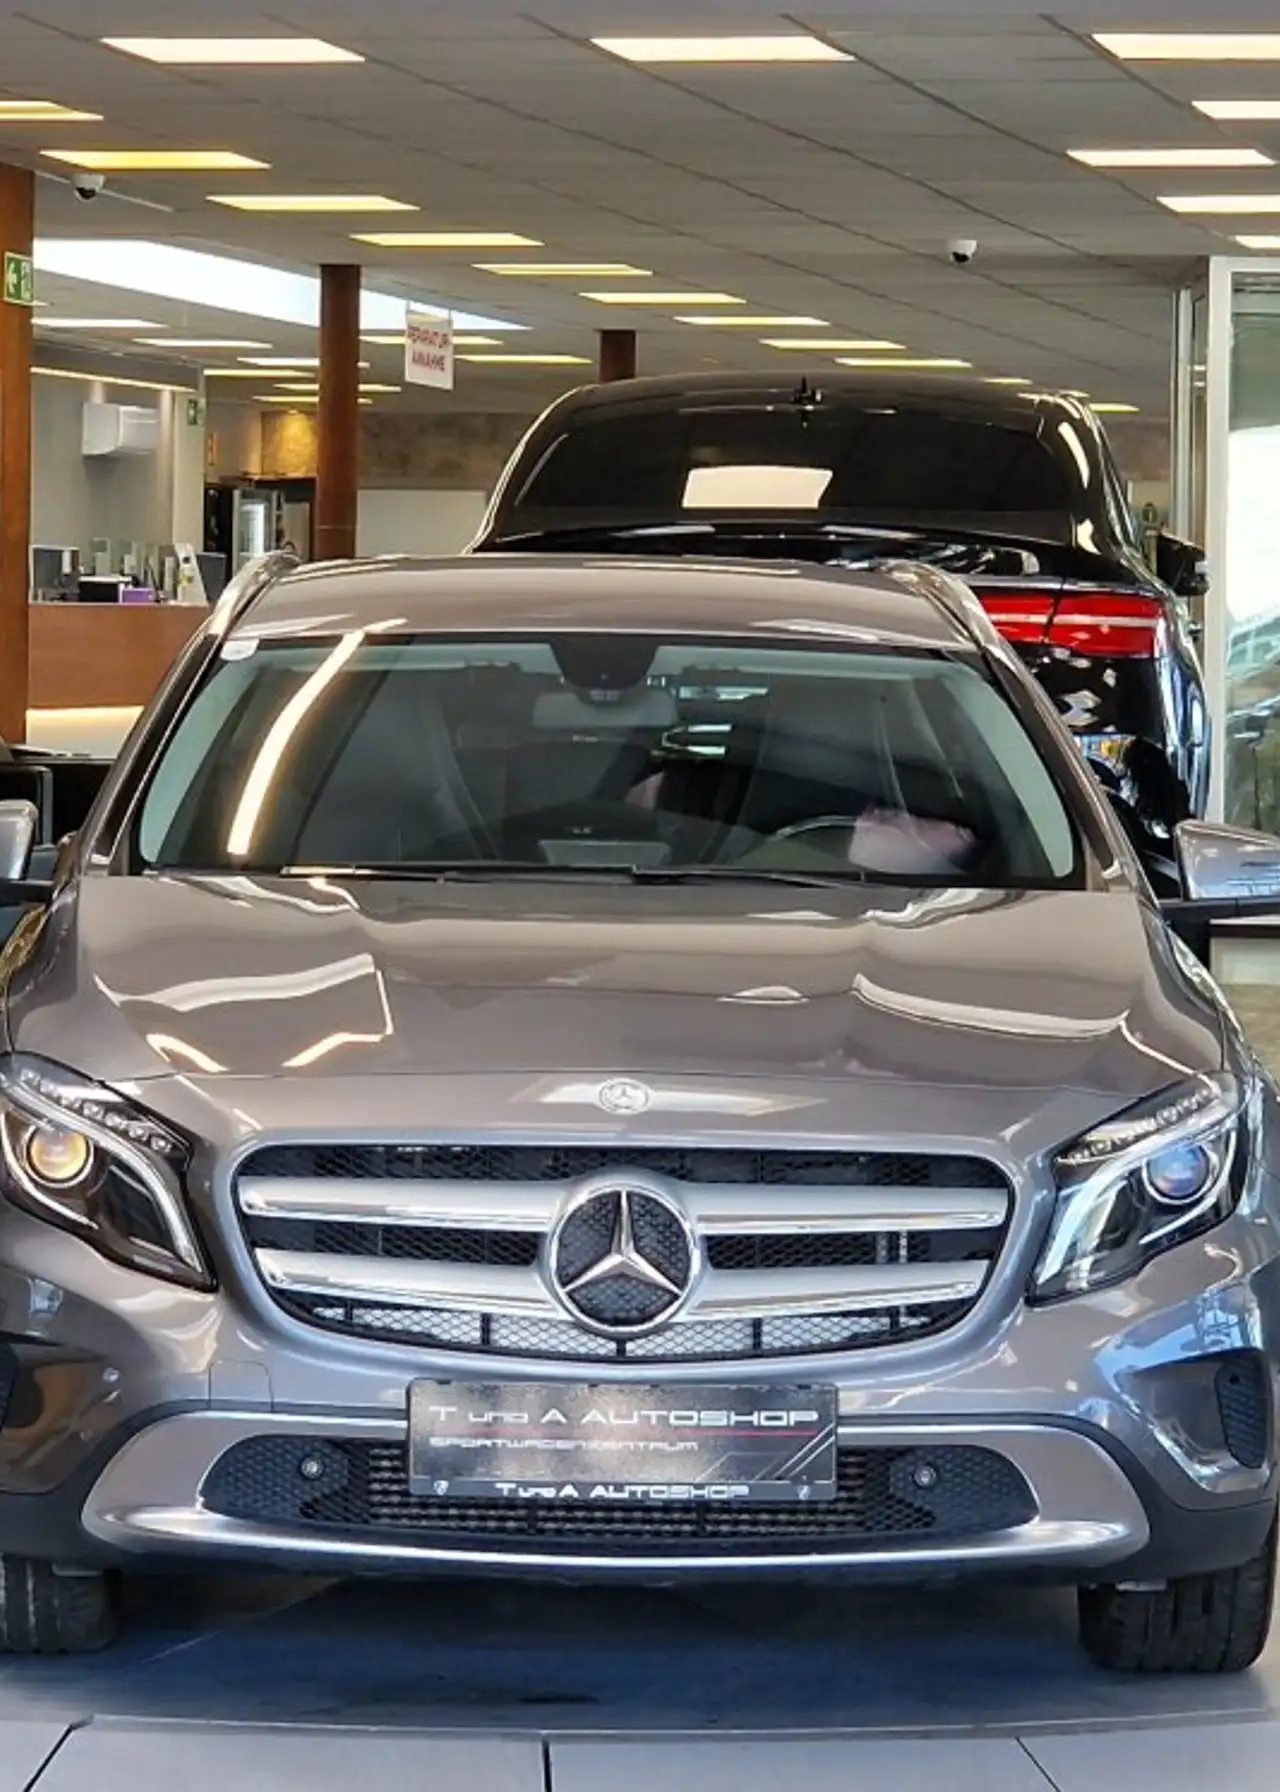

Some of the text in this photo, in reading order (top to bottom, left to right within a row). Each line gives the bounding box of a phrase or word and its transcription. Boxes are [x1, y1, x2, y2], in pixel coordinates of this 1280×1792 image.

[429, 1406, 457, 1422] T
[540, 1408, 567, 1424] A
[581, 1409, 819, 1427] AUTOSHOP
[495, 1482, 517, 1497] T
[558, 1484, 579, 1498] A
[590, 1484, 749, 1499] AUTOSHOP
